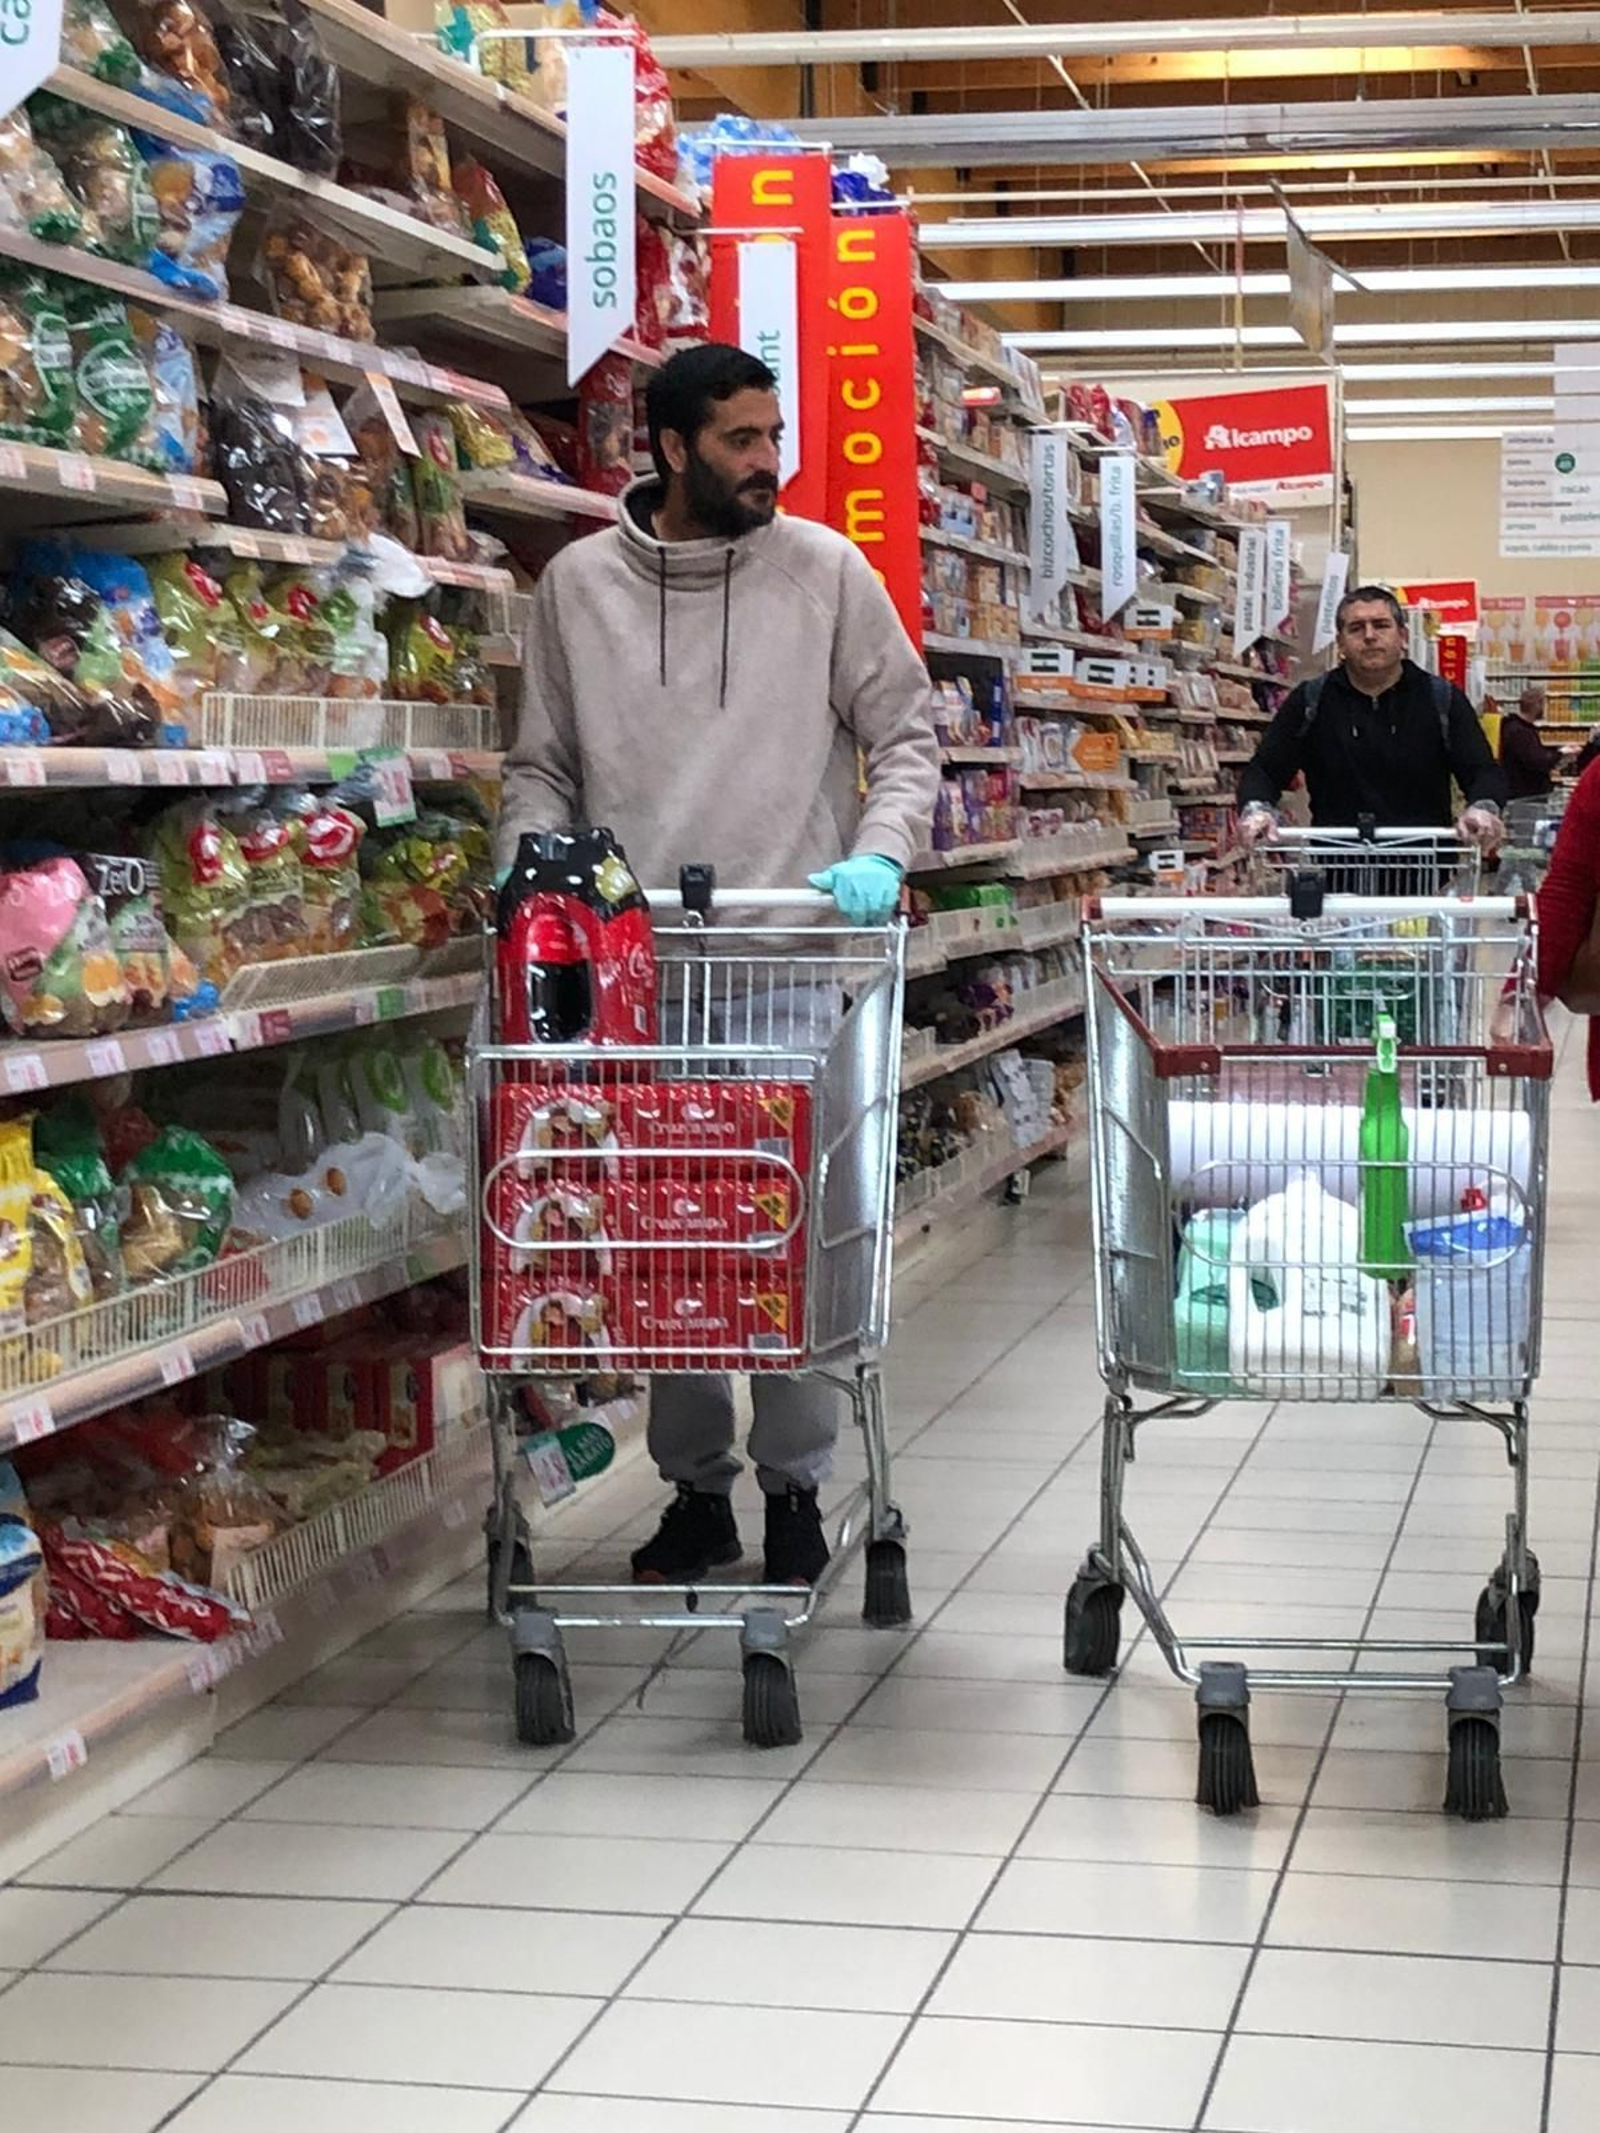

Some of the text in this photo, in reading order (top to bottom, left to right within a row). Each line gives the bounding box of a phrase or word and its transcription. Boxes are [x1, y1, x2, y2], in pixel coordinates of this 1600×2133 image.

[585, 172, 617, 309] sobaos
[827, 229, 885, 583] moción
[1204, 424, 1314, 450] Alcampo
[1041, 444, 1056, 579] bizcochos/tortas
